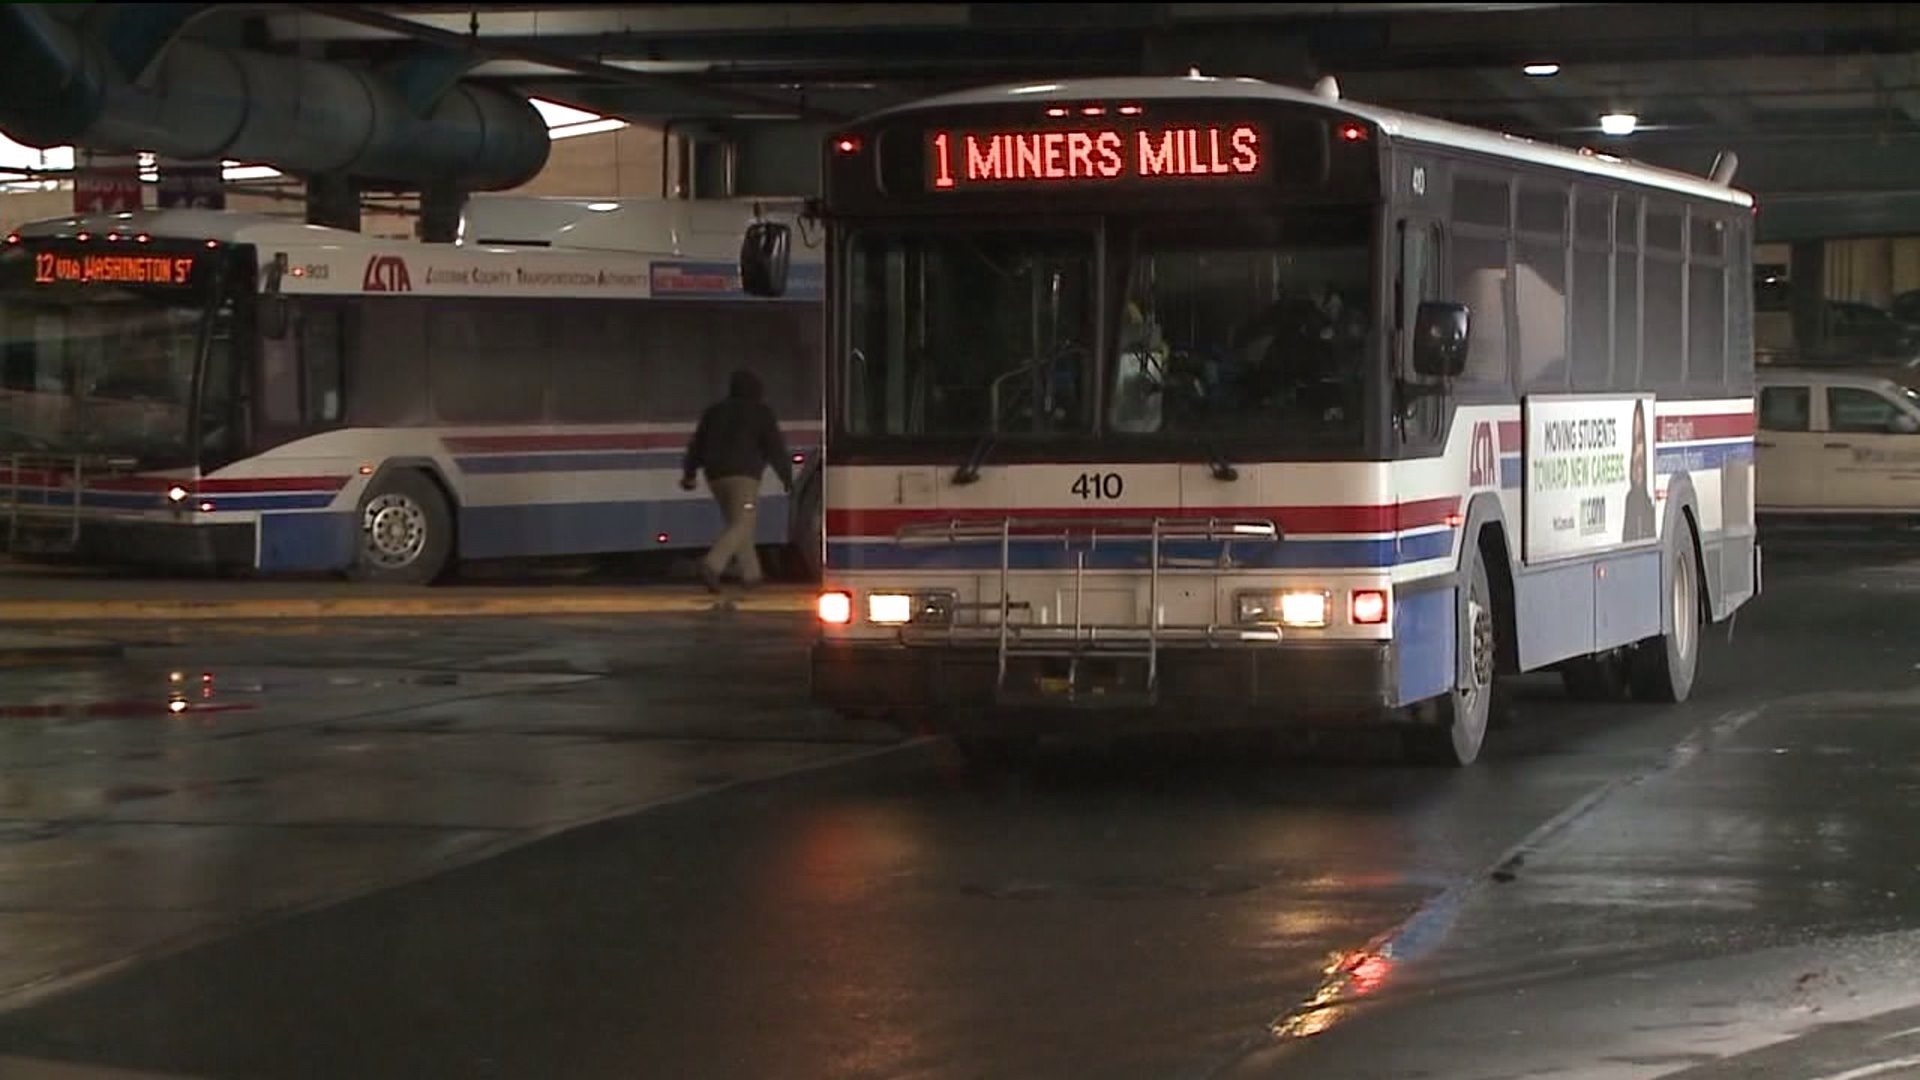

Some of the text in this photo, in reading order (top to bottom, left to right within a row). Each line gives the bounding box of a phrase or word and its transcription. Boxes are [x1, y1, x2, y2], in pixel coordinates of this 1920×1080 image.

[935, 127, 1258, 187] 1 MINERS MILLS
[35, 253, 54, 282] 12
[83, 257, 172, 282] WASHINGTON
[174, 258, 193, 283] ST
[1544, 417, 1617, 454] MOVING STUDENTS
[1071, 472, 1123, 499] 410
